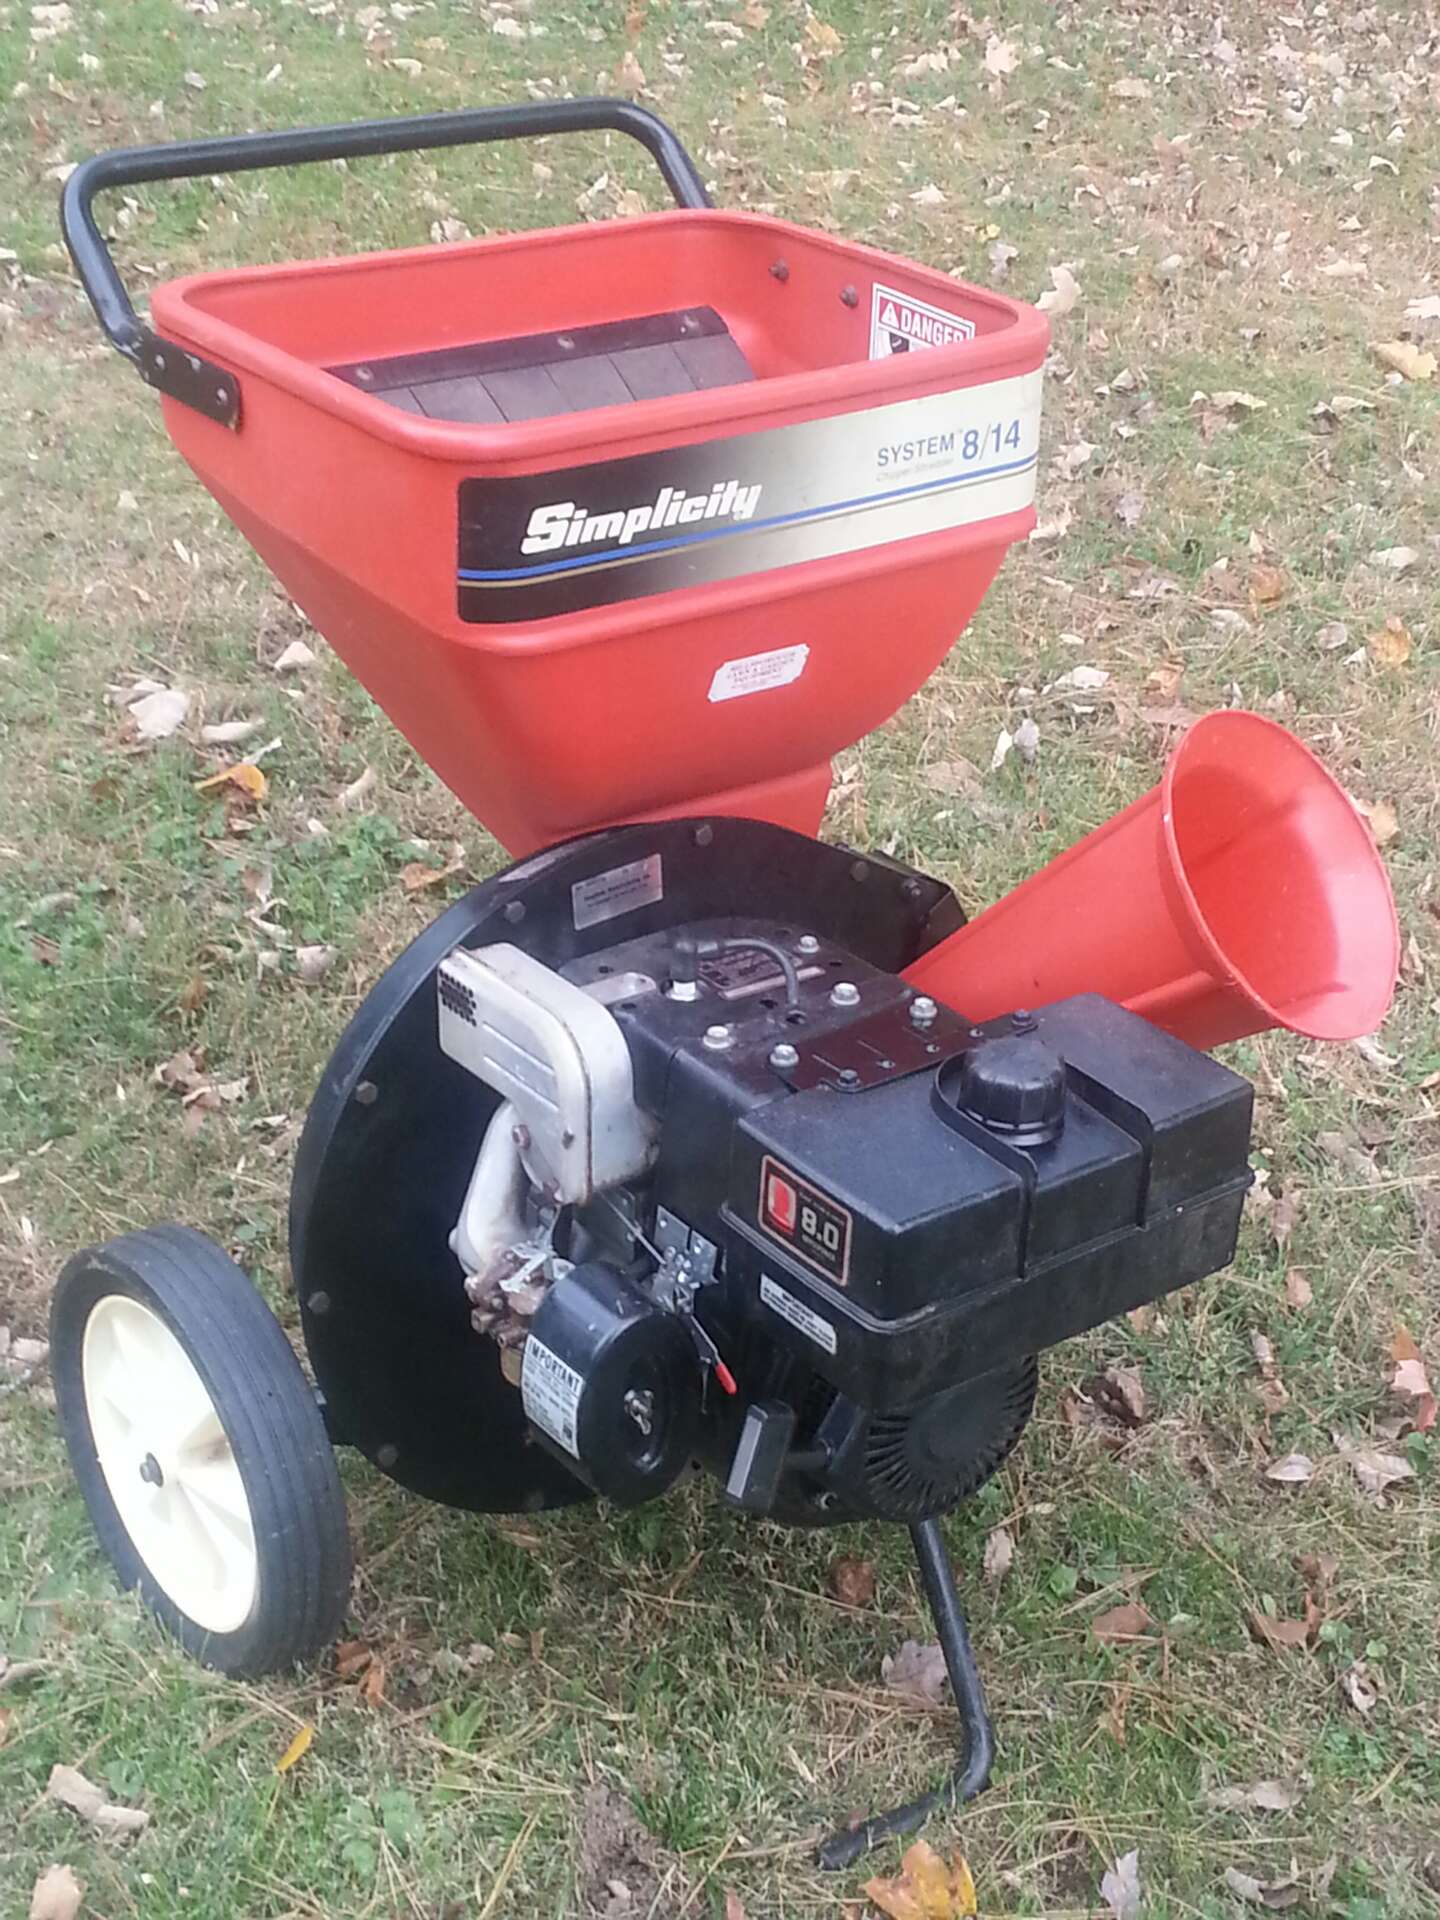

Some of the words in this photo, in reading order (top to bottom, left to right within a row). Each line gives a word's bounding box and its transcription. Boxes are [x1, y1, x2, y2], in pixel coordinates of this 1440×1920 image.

[877, 432, 954, 467] SYSTEM
[962, 419, 1021, 461] 8/14
[520, 479, 763, 555] Simplicity
[800, 1205, 840, 1251] 8.0
[527, 1338, 581, 1394] IMPORTANT
